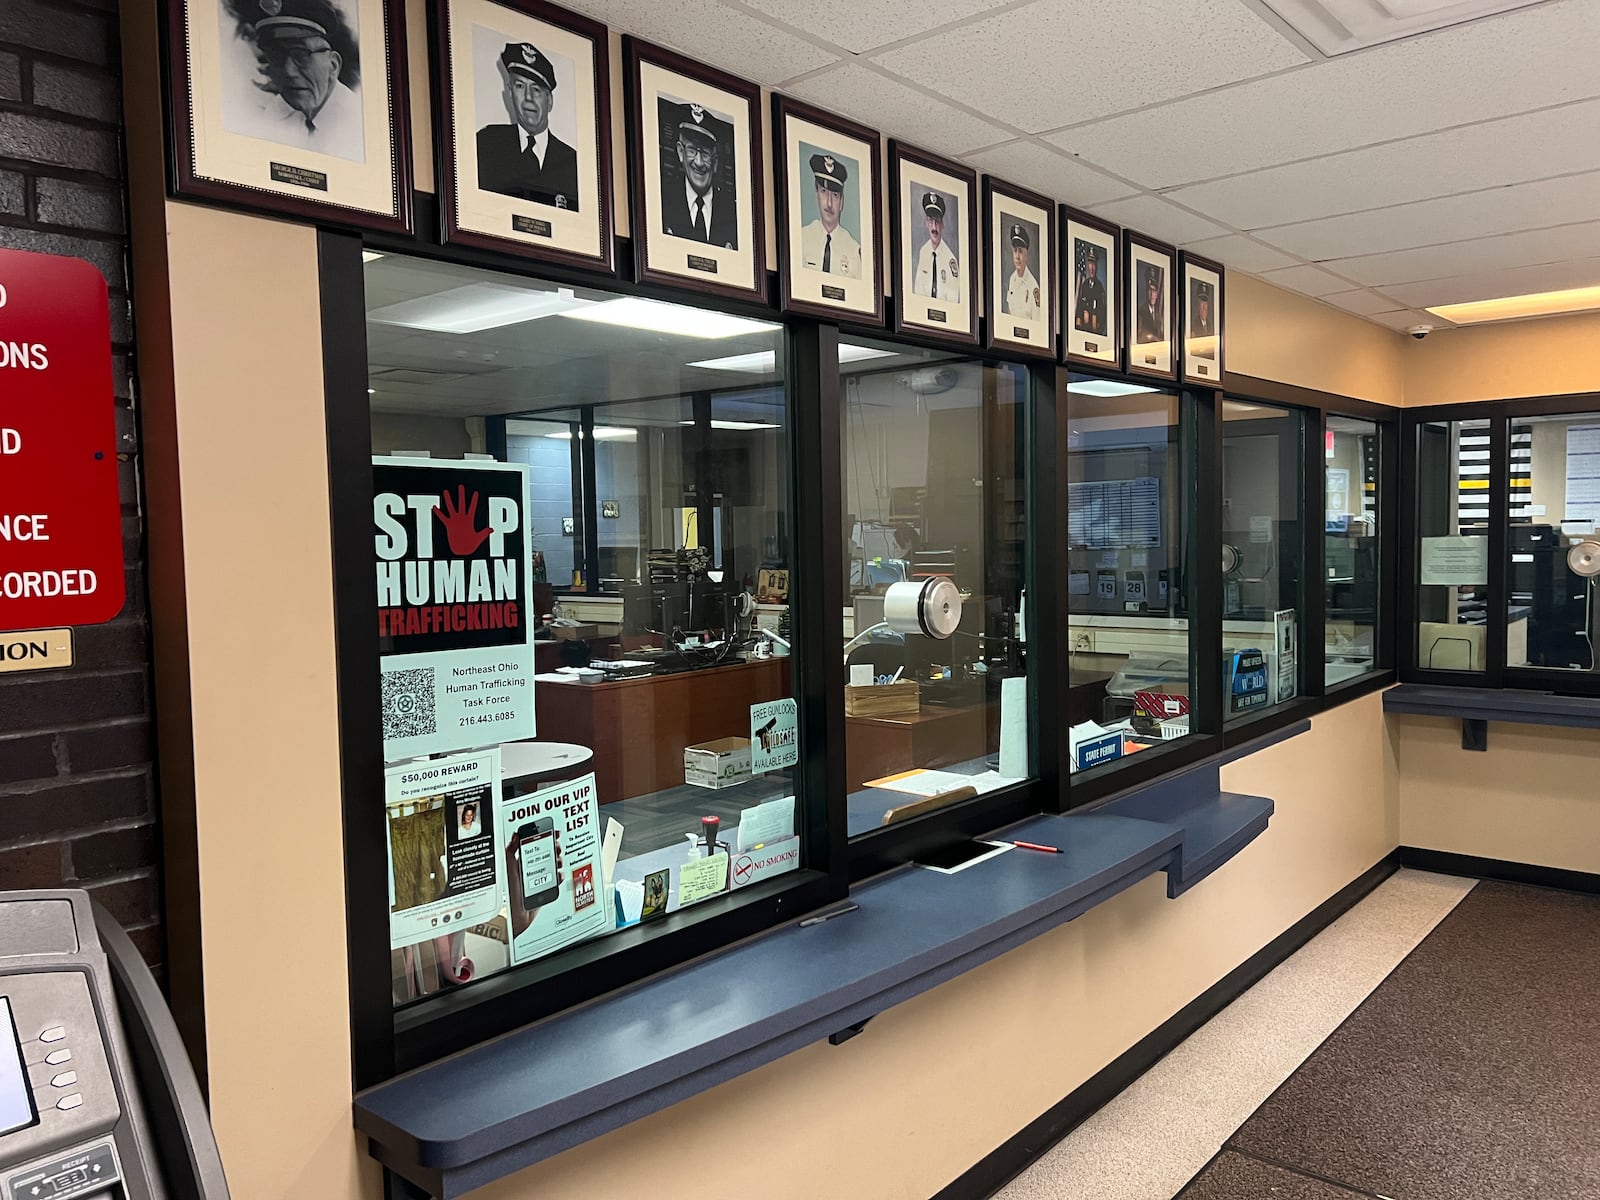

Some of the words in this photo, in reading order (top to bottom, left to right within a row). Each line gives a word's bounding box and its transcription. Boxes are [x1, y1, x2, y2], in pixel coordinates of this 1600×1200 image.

[373, 492, 519, 560] STP
[0, 569, 97, 598] ORDED
[376, 559, 517, 607] HUMAN
[1100, 583, 1113, 593] 19
[1127, 583, 1141, 593] 28
[378, 602, 519, 638] TRAFFICKING
[452, 665, 496, 677] Northeast
[498, 662, 519, 672] Ohio
[446, 683, 478, 694] Human
[480, 677, 526, 690] Trafficking
[463, 698, 483, 708] Task
[486, 695, 510, 705] Force
[459, 710, 515, 727] 216.443.6085
[753, 707, 767, 722] FREE
[768, 703, 796, 717] GUNLOCKS
[754, 755, 782, 769] AVAILABLE
[782, 751, 797, 764] HERE
[1085, 748, 1100, 762] STATE
[401, 769, 439, 783] $50,000
[441, 762, 478, 776] REWARD
[410, 788, 420, 796] you
[508, 802, 541, 822] JOIN
[544, 793, 570, 811] OUR
[572, 785, 590, 801] VIP
[563, 800, 590, 819] TEXT
[566, 814, 590, 832] LIST
[754, 860, 765, 870] NO
[766, 849, 798, 866] SMOKING
[534, 875, 548, 886] CITY
[62, 1155, 90, 1170] RECEIPT
